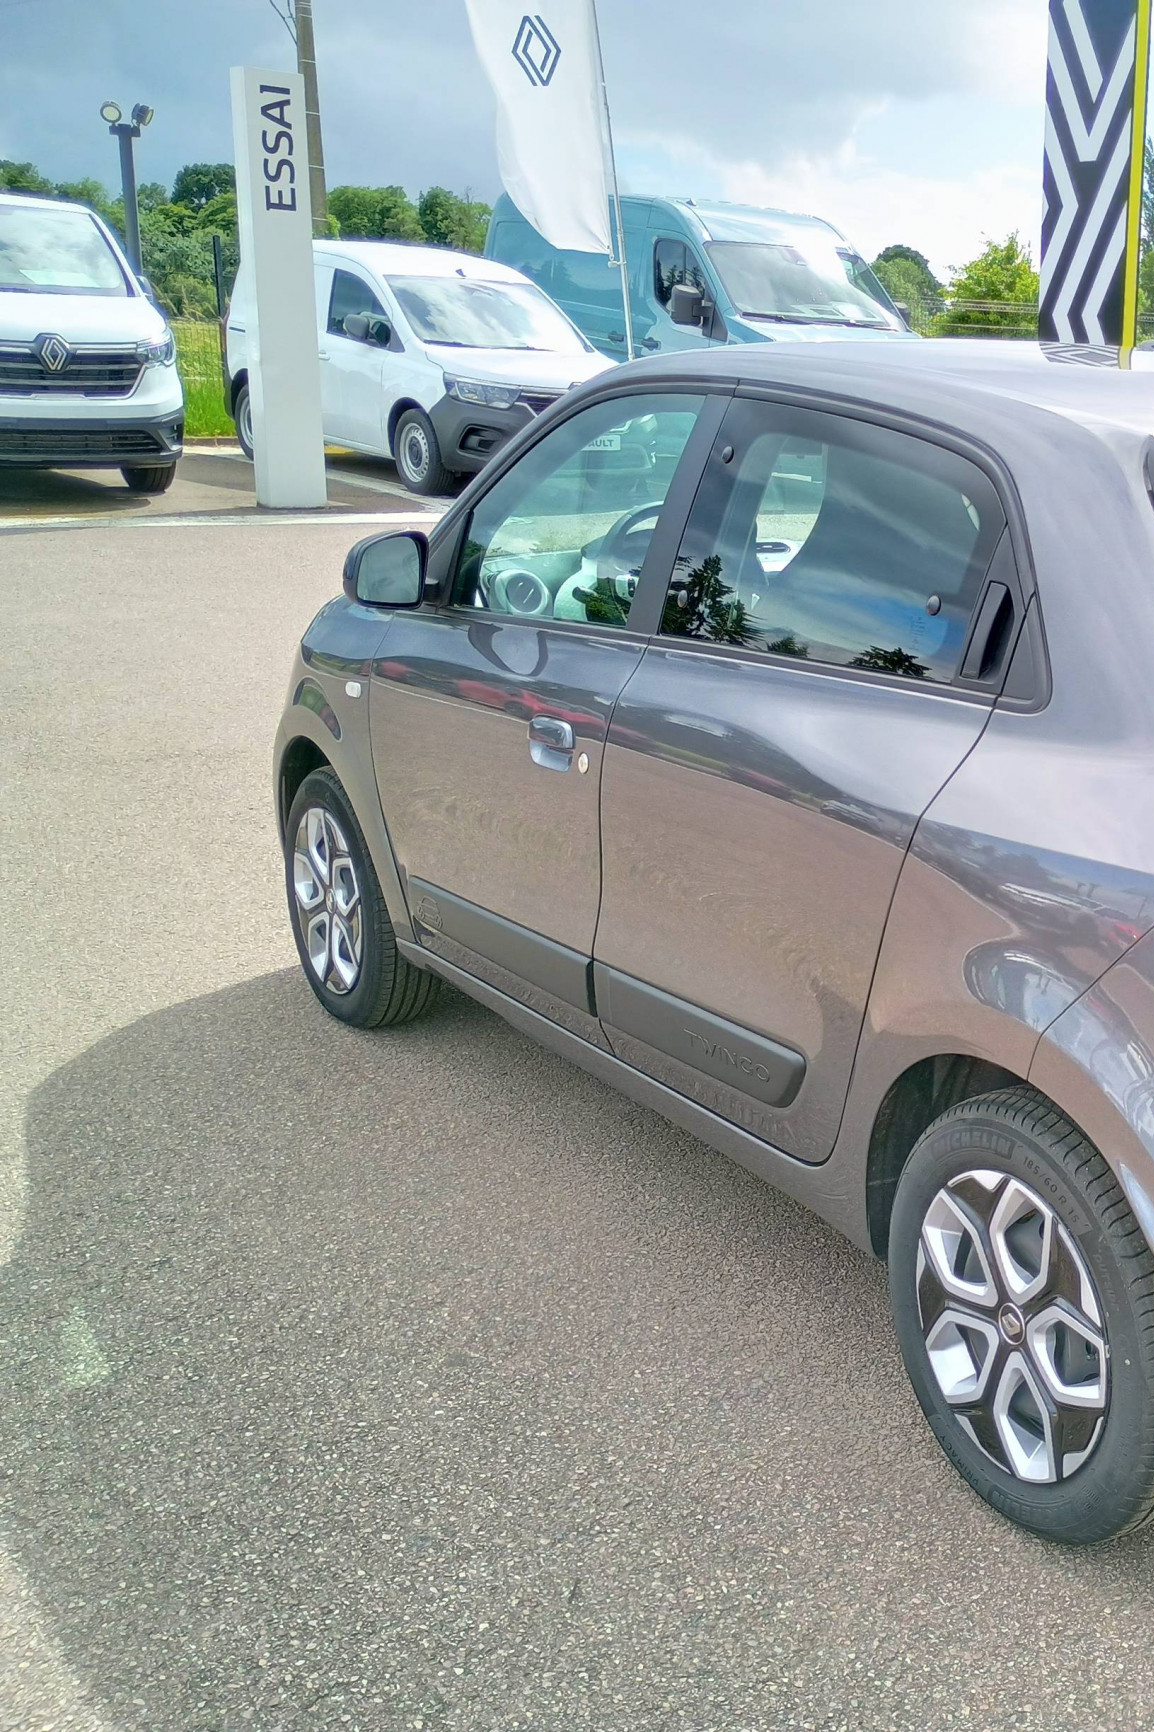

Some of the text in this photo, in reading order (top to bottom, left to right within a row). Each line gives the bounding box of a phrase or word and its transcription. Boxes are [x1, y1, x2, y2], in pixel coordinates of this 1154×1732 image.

[260, 84, 297, 211] ESSAI
[683, 1028, 770, 1083] TWINGO
[1023, 1156, 1058, 1193] 185/60
